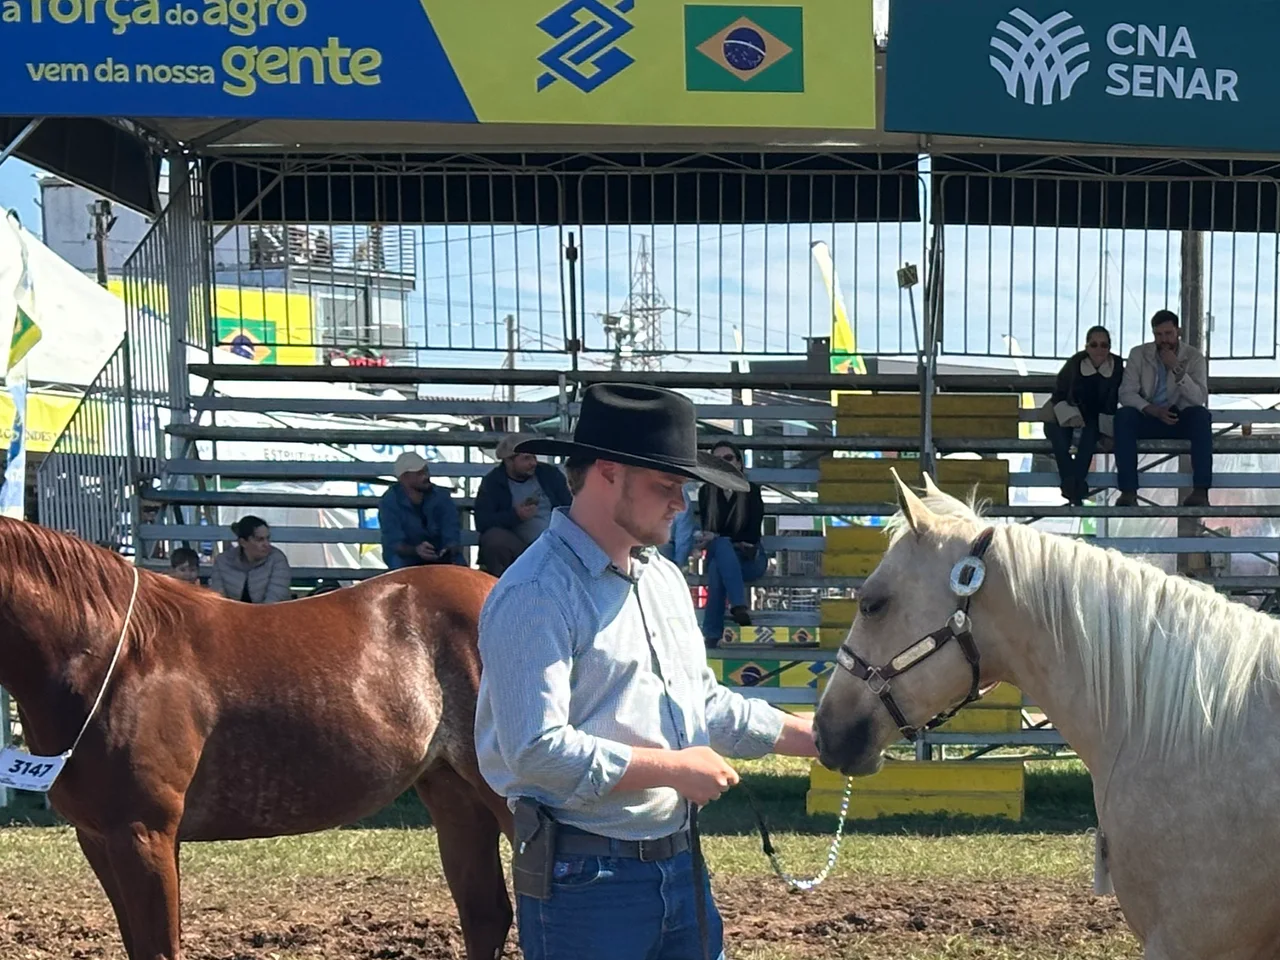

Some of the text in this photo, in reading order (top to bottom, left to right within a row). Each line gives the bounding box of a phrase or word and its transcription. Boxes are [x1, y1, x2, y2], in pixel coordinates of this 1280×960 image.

[2, 0, 21, 22] a
[165, 3, 199, 25] do
[203, 0, 307, 36] agro
[1106, 22, 1197, 58] CNA
[26, 37, 382, 97] vem da nossa gente
[1105, 62, 1239, 102] SENAR
[8, 759, 54, 777] 3147
